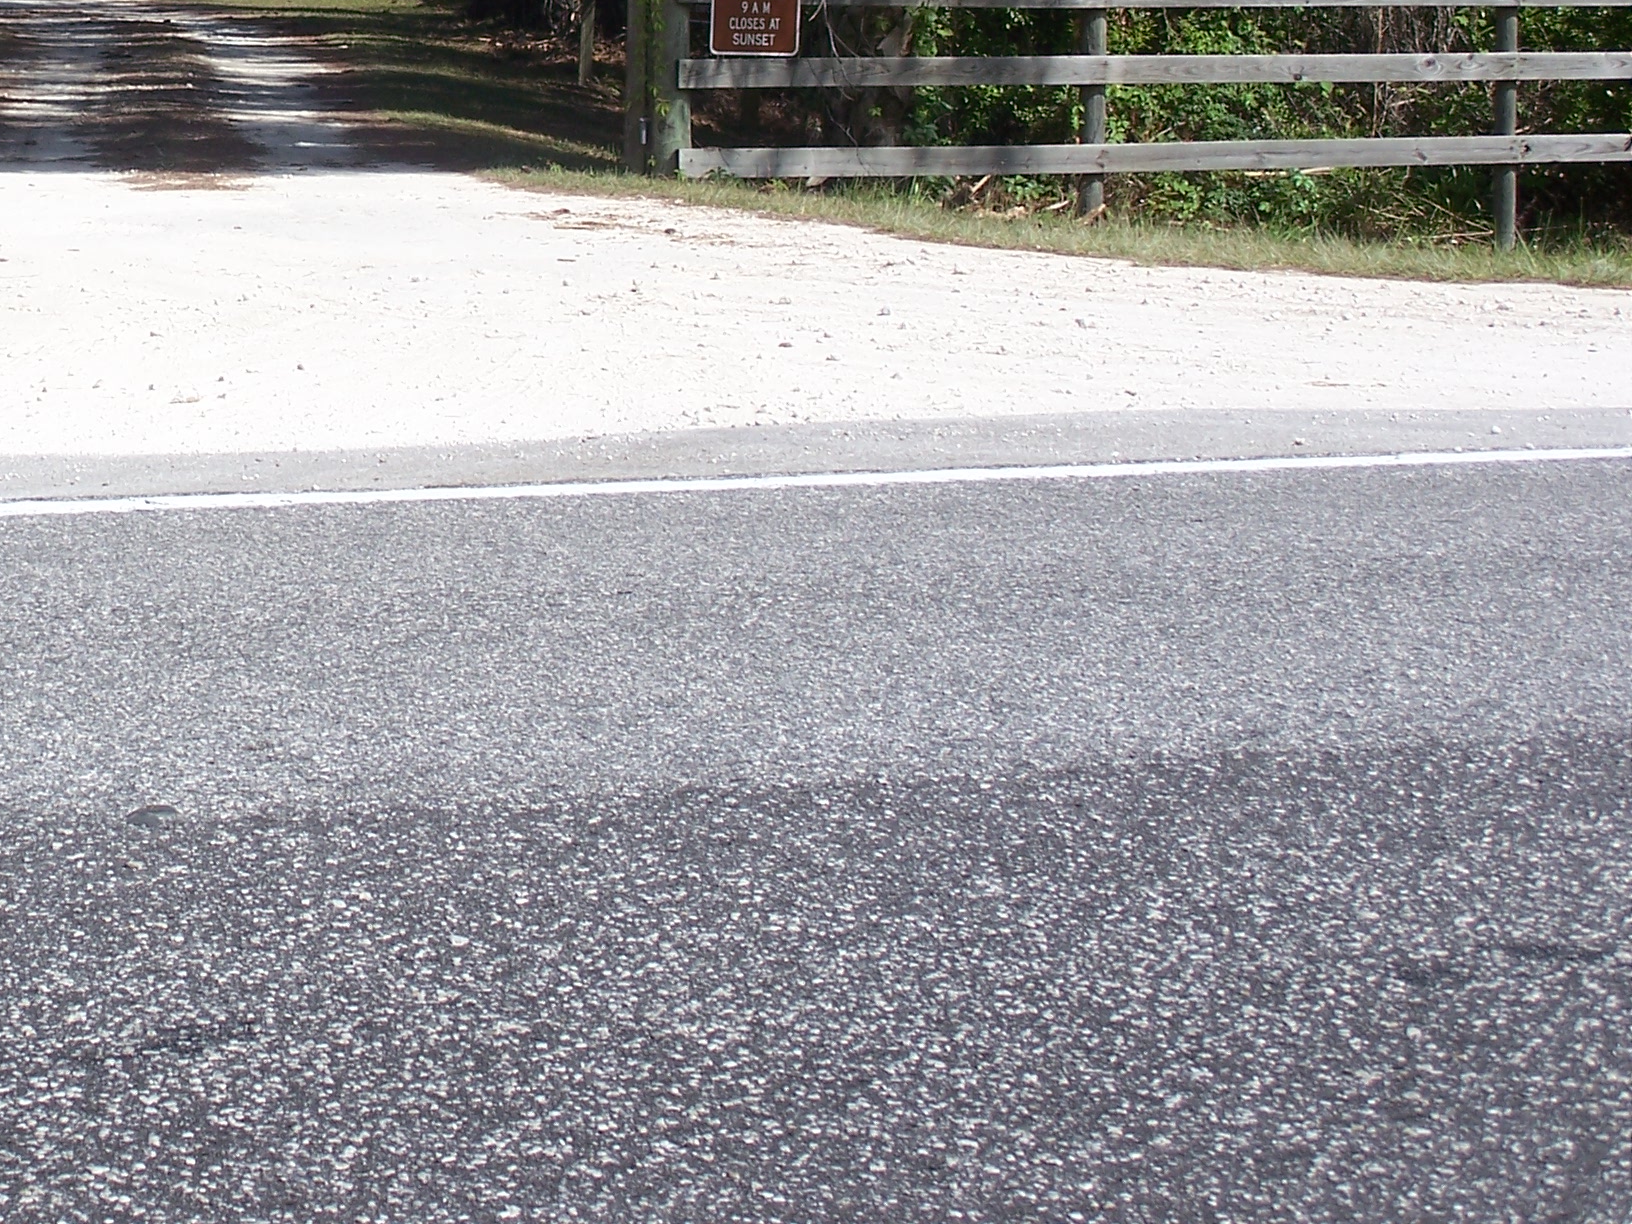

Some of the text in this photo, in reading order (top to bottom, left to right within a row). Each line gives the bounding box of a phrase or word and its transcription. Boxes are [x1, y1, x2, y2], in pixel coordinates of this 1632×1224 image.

[741, 1, 770, 14] 9 A M
[729, 17, 781, 30] CLOSES AT
[732, 33, 776, 46] SUNSET
